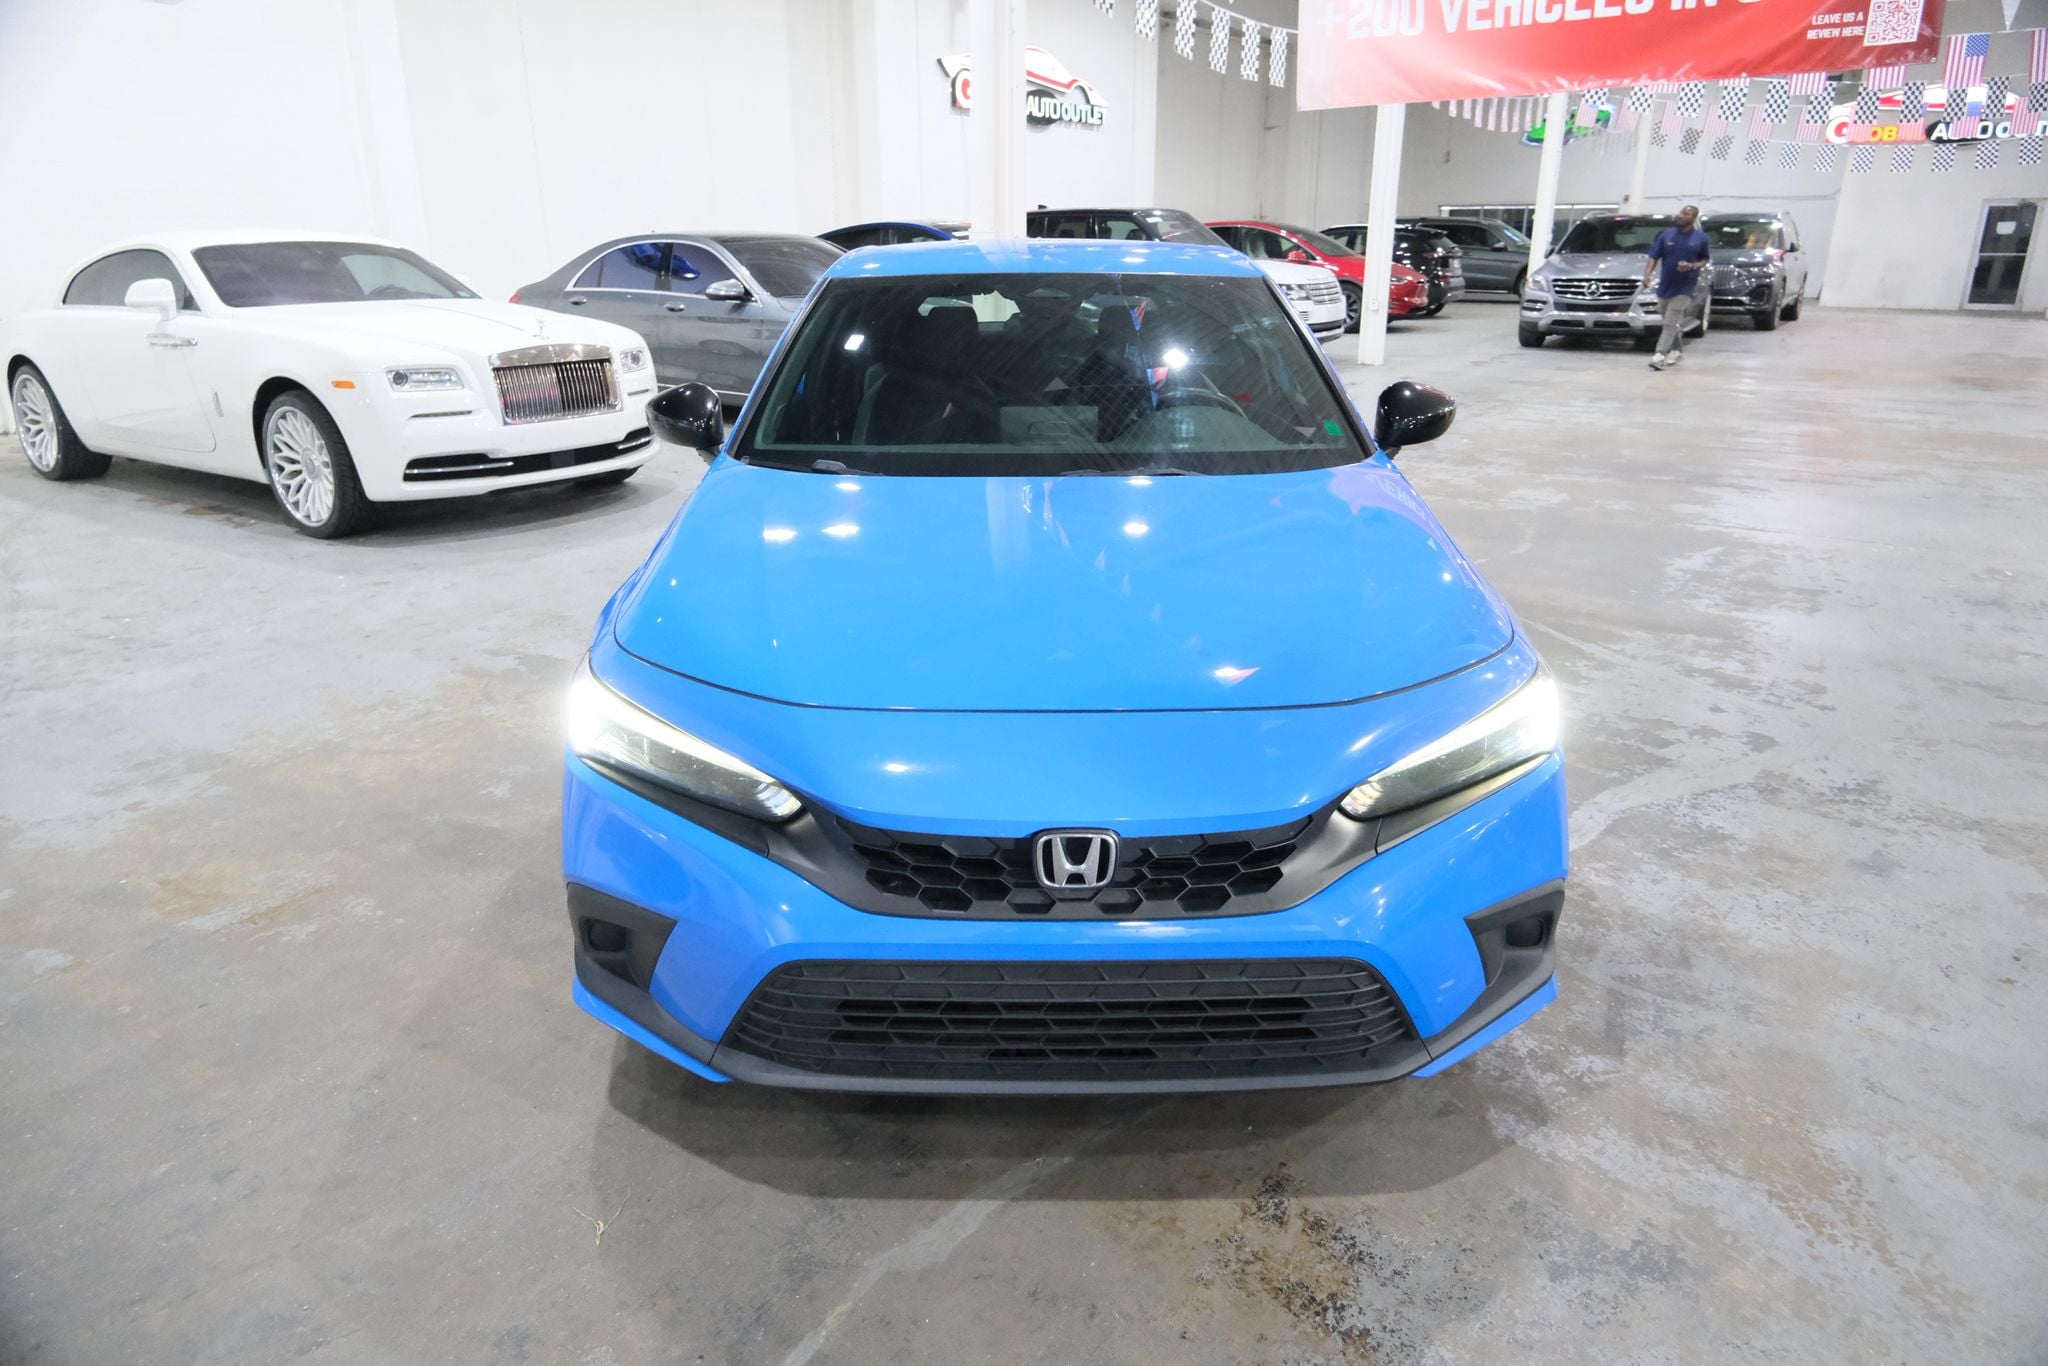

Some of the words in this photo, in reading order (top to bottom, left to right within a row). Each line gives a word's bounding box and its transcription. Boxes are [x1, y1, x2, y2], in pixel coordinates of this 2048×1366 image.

[1811, 13, 1842, 25] LEAVE
[1842, 12, 1856, 23] US
[1856, 11, 1864, 21] A
[1806, 27, 1841, 40] REVIEW
[1841, 26, 1865, 37] HERE
[1026, 95, 1060, 119] AUTO
[1061, 104, 1107, 125] OUTLET
[1930, 121, 1994, 140] AO
